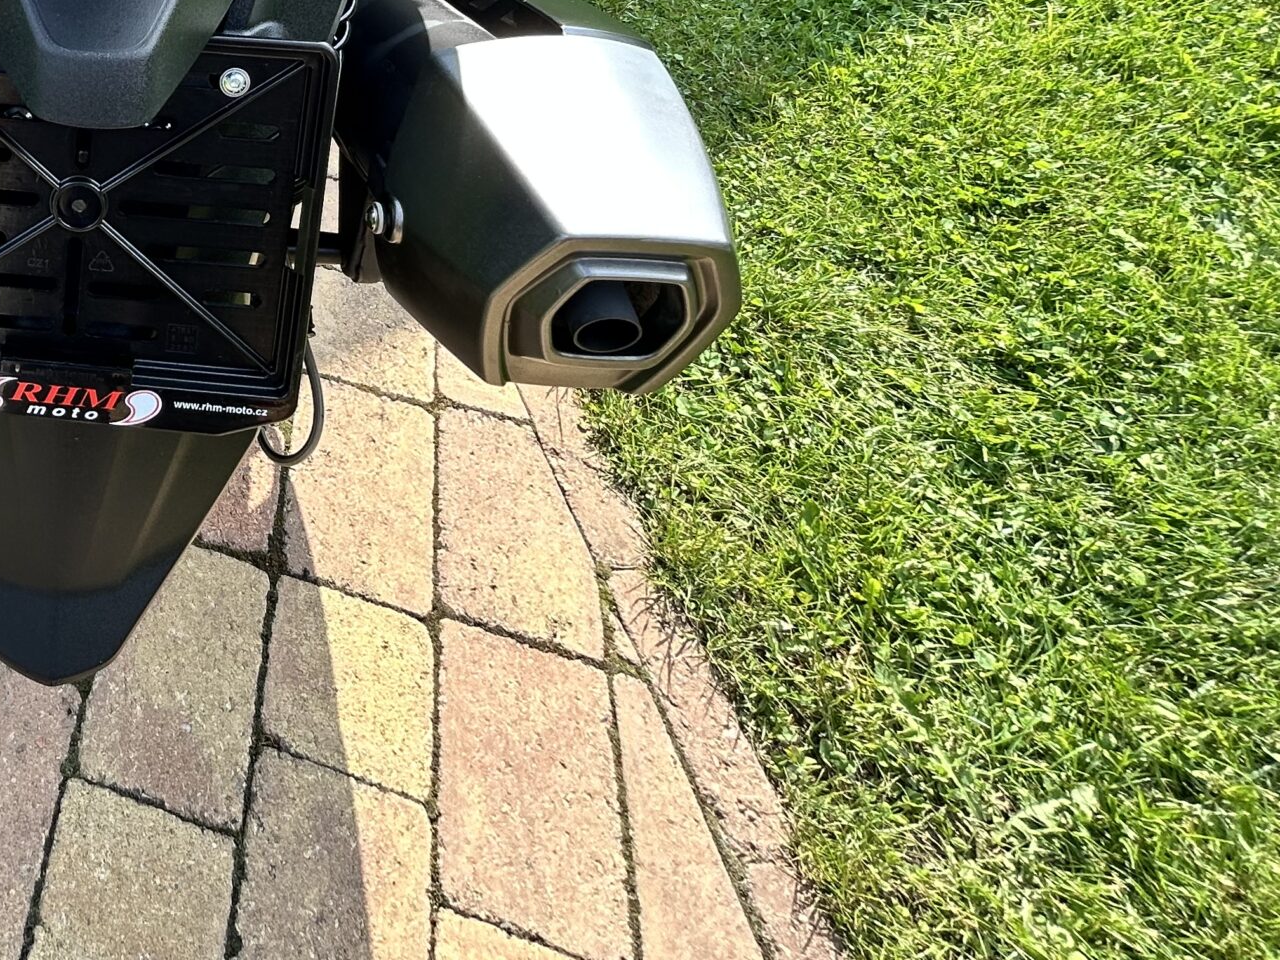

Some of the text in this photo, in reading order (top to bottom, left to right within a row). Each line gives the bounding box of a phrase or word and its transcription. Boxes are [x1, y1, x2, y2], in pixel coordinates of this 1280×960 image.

[9, 381, 125, 411] RHM
[26, 405, 99, 420] moto
[173, 401, 268, 417] www.rhm-moto.cz
